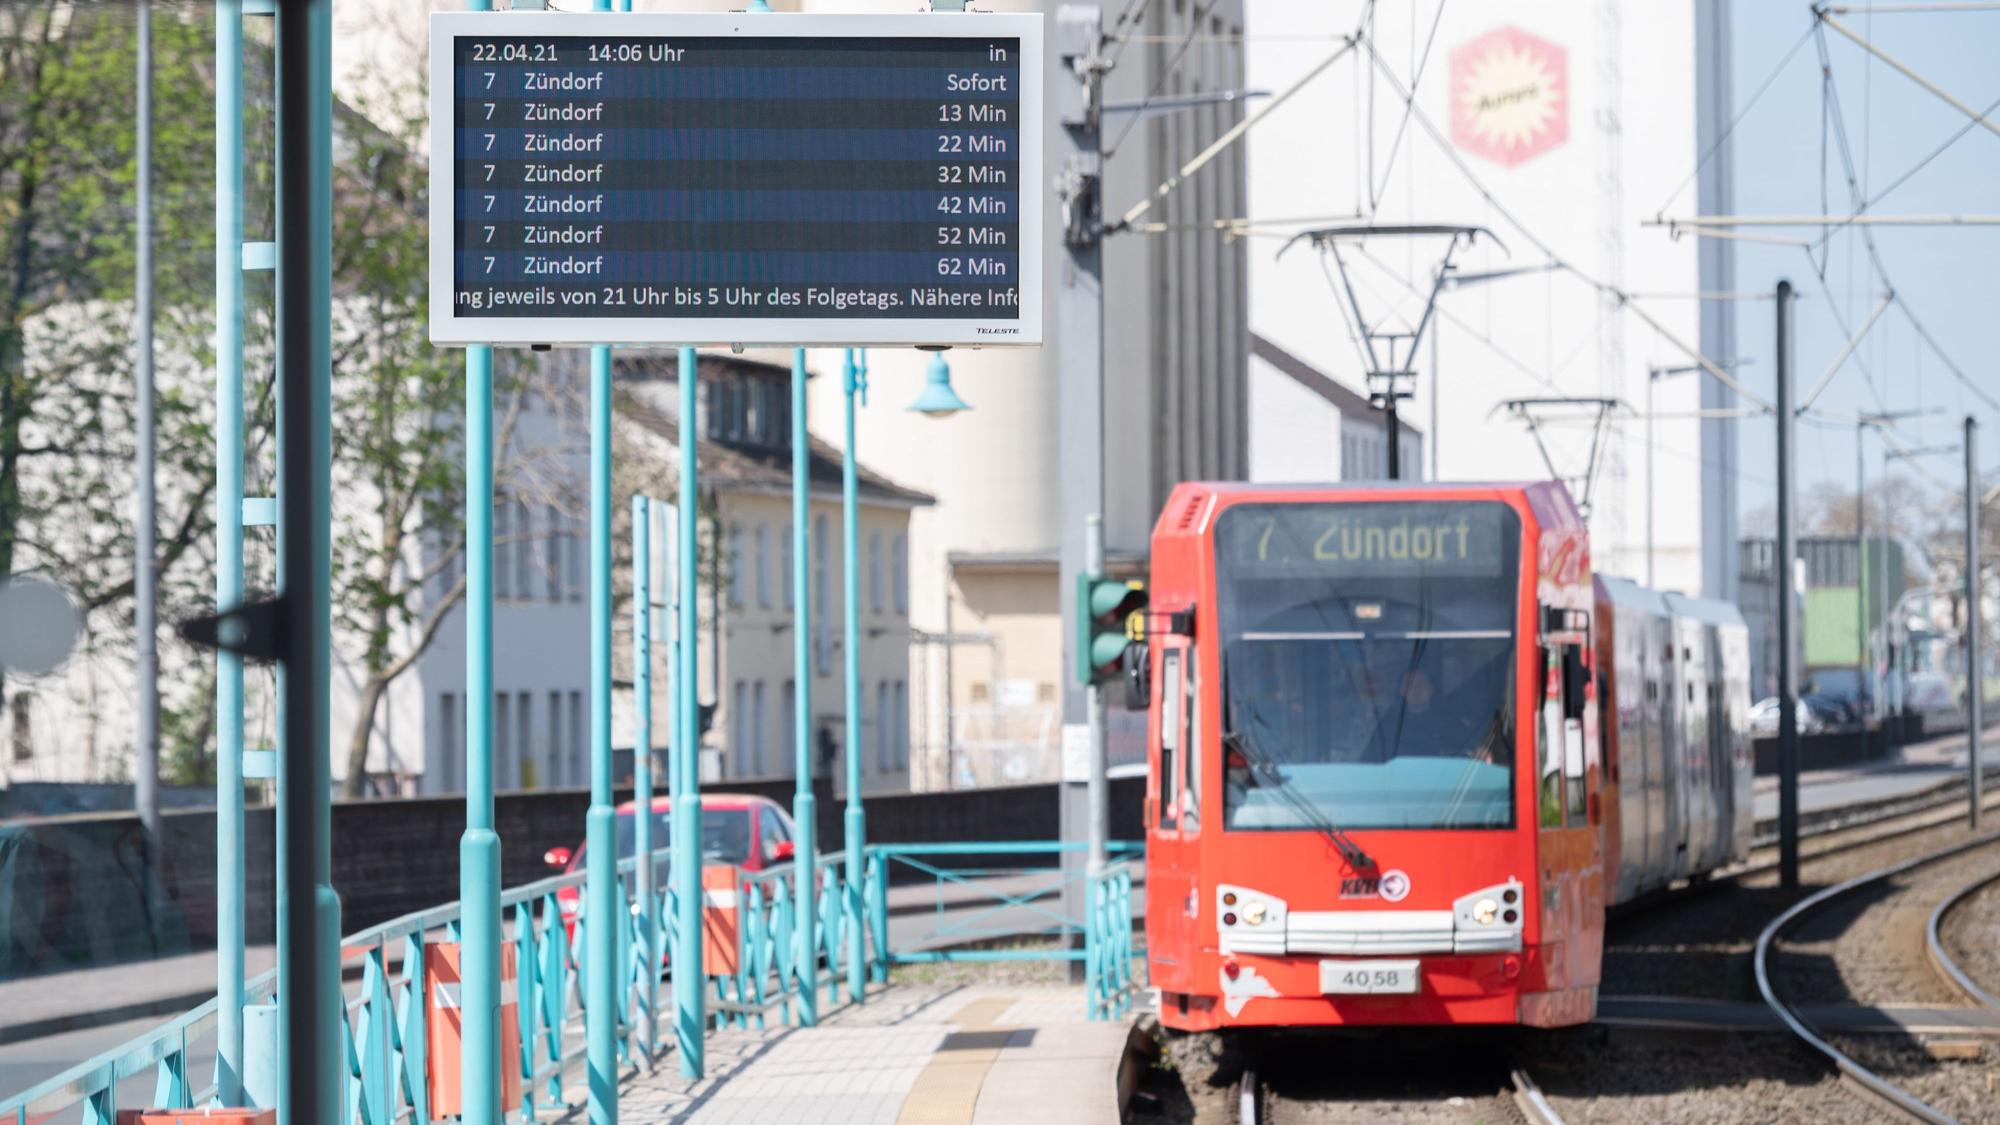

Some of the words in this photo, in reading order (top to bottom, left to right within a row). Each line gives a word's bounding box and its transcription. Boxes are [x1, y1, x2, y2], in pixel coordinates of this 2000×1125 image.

[472, 44, 558, 62] 22.04.21
[588, 44, 643, 62] 14:06
[648, 44, 685, 62] Uhr
[989, 44, 1007, 62] in
[483, 72, 496, 90] 7
[524, 71, 603, 91] Zündorf
[947, 73, 1007, 92] Sofort
[483, 102, 496, 121] 7
[524, 102, 603, 121] Zündorf
[938, 104, 962, 122] 13
[968, 104, 1007, 122] Min
[483, 133, 496, 152] 7
[524, 133, 603, 152] Zündorf
[938, 135, 962, 153] 22
[968, 135, 1007, 153] Min
[483, 163, 496, 182] 7
[524, 163, 603, 182] Zündorf
[938, 165, 962, 183] 32
[968, 165, 1007, 183] Min
[483, 194, 496, 213] 7
[524, 194, 603, 213] Zündorf
[938, 196, 962, 214] 42
[968, 196, 1007, 214] Min
[483, 225, 496, 244] 7
[524, 225, 603, 244] Zündorf
[938, 227, 962, 245] 52
[968, 227, 1007, 245] Min
[483, 255, 496, 274] 7
[524, 255, 603, 274] Zündorf
[938, 257, 962, 275] 62
[968, 257, 1007, 275] Min
[456, 290, 483, 309] ng
[486, 286, 556, 310] jeweils
[560, 290, 597, 305] von
[603, 287, 627, 305] 21
[633, 286, 670, 305] Uhr
[675, 286, 702, 305] bis
[707, 287, 719, 305] 5
[726, 286, 762, 306] Uhr
[767, 286, 801, 306] des
[807, 286, 904, 311] Folgetags.
[911, 287, 982, 306] Nähere
[1313, 513, 1471, 561] Zündorf
